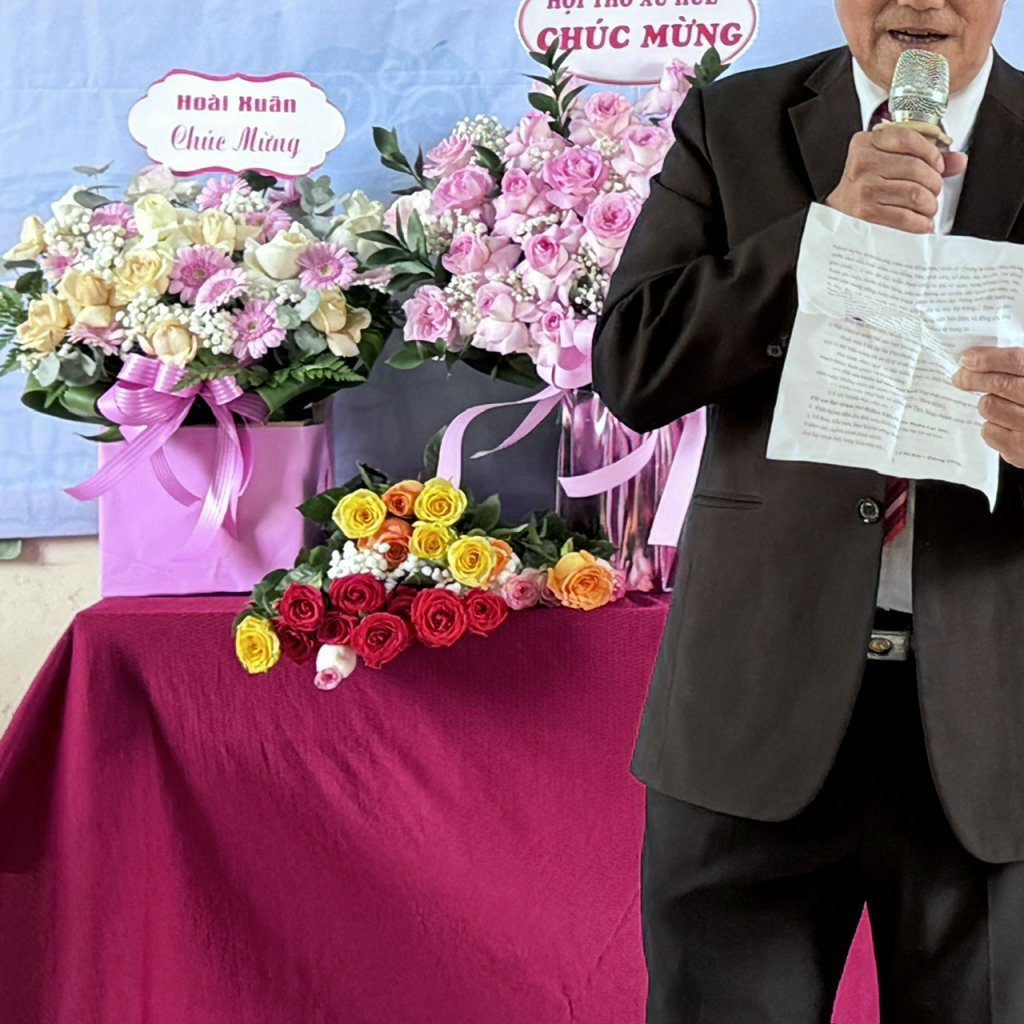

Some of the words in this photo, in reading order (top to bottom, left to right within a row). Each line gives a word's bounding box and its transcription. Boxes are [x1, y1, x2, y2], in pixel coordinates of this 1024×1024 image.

[536, 18, 631, 51] CHÚC
[640, 16, 743, 48] MỪNG
[238, 94, 297, 113] Xuân
[170, 124, 227, 152] Chúc
[231, 126, 301, 159] Mừng
